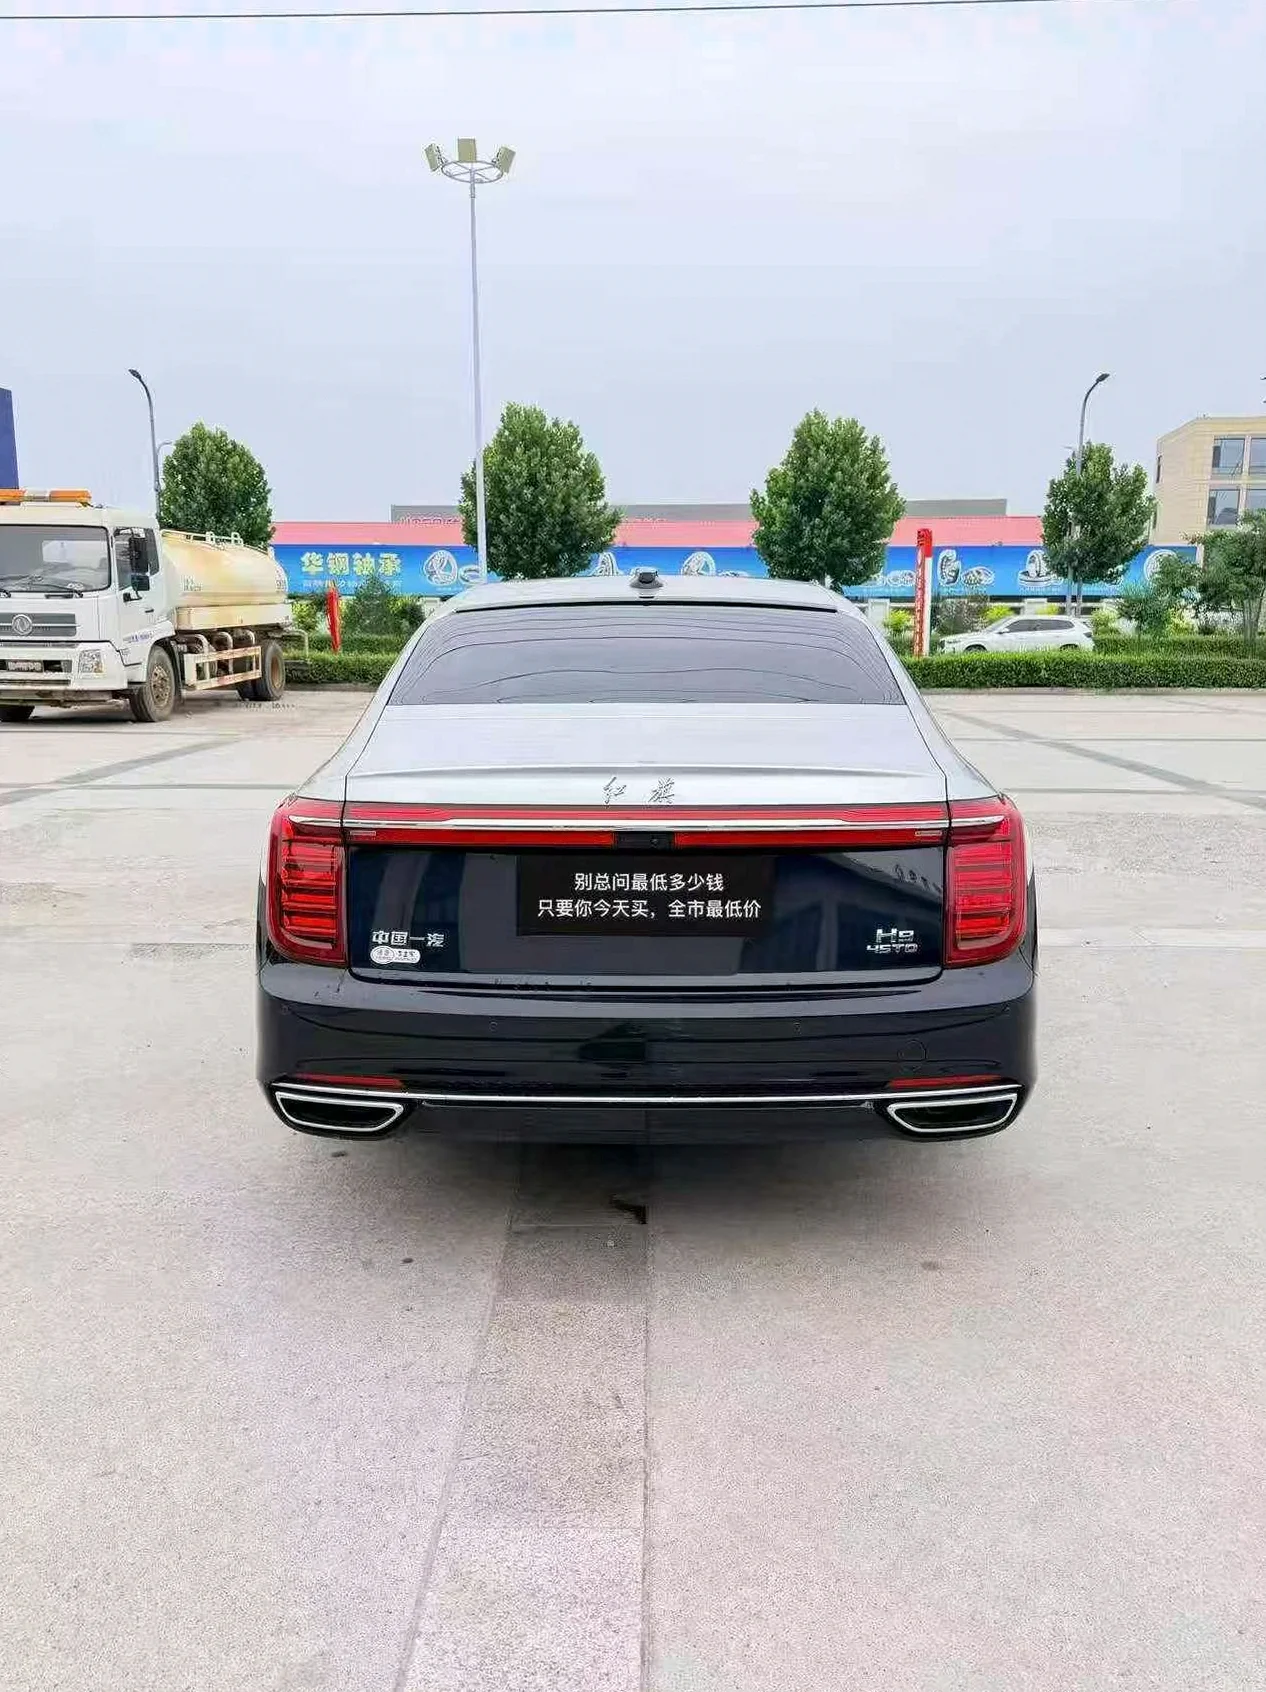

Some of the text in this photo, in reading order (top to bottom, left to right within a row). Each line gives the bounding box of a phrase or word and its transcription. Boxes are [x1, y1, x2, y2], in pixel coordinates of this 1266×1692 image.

[372, 930, 444, 947] 中国一汽
[876, 928, 914, 943] H9
